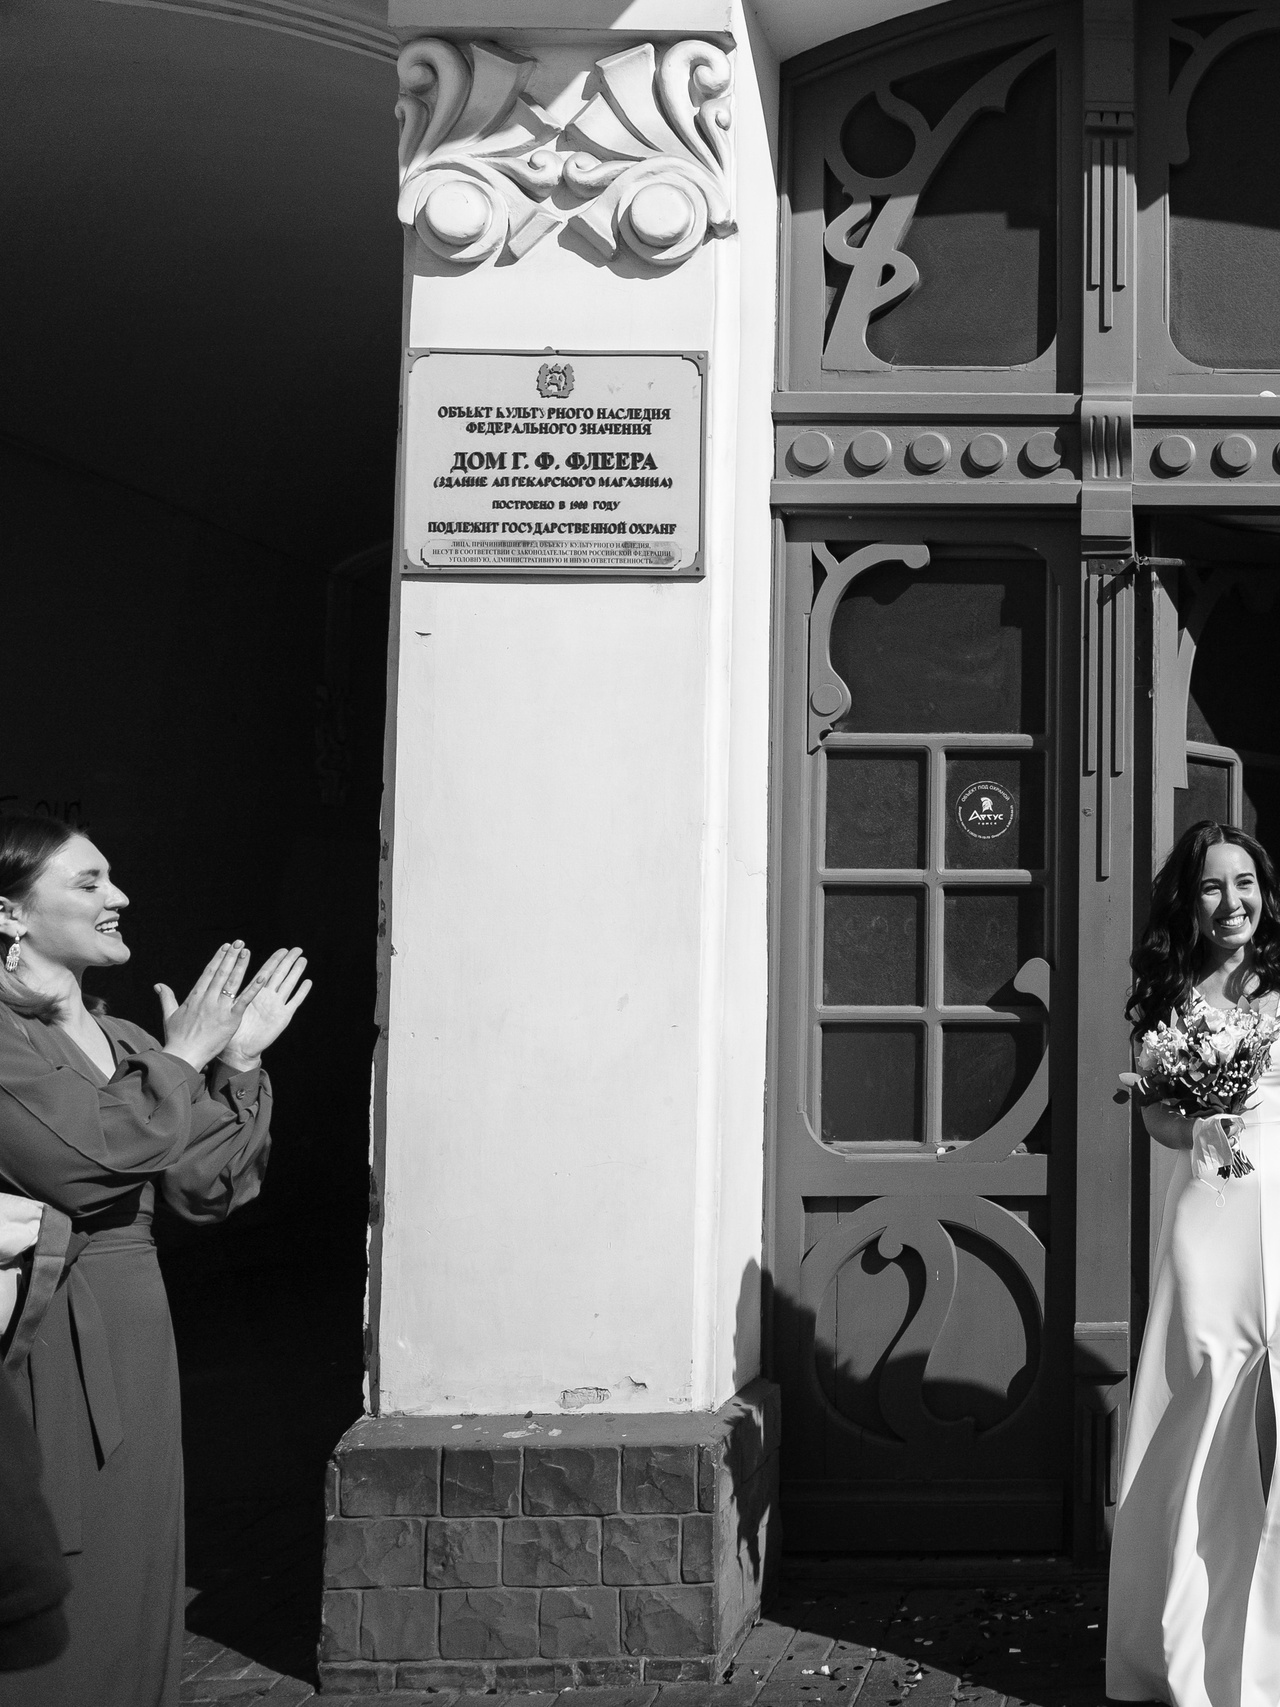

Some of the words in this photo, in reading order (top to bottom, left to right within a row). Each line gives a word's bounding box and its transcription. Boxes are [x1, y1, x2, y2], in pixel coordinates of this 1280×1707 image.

[437, 406, 493, 419] ОБЪЕКТ
[596, 407, 671, 422] НАСЛЕДИЯ
[465, 421, 577, 436] ФЕДЕРАЛЬНОГО
[579, 422, 652, 436] ЗНАЧЕНИЯ
[449, 451, 507, 474] ДОМ
[511, 451, 529, 470] Г.
[534, 451, 560, 471] Ф.
[564, 451, 659, 471] ФЛЕЕРА
[433, 476, 488, 489] (ЗДАНИЕ
[598, 476, 673, 489] МАГАЗИНА)
[492, 499, 555, 510] ПОСТРОЕНО
[558, 500, 566, 510] В
[592, 500, 621, 511] ГОДУ
[427, 521, 500, 535] ПОДЛЕЖИТ
[501, 520, 627, 536] ГОСУДАРСТВЕННОЙ
